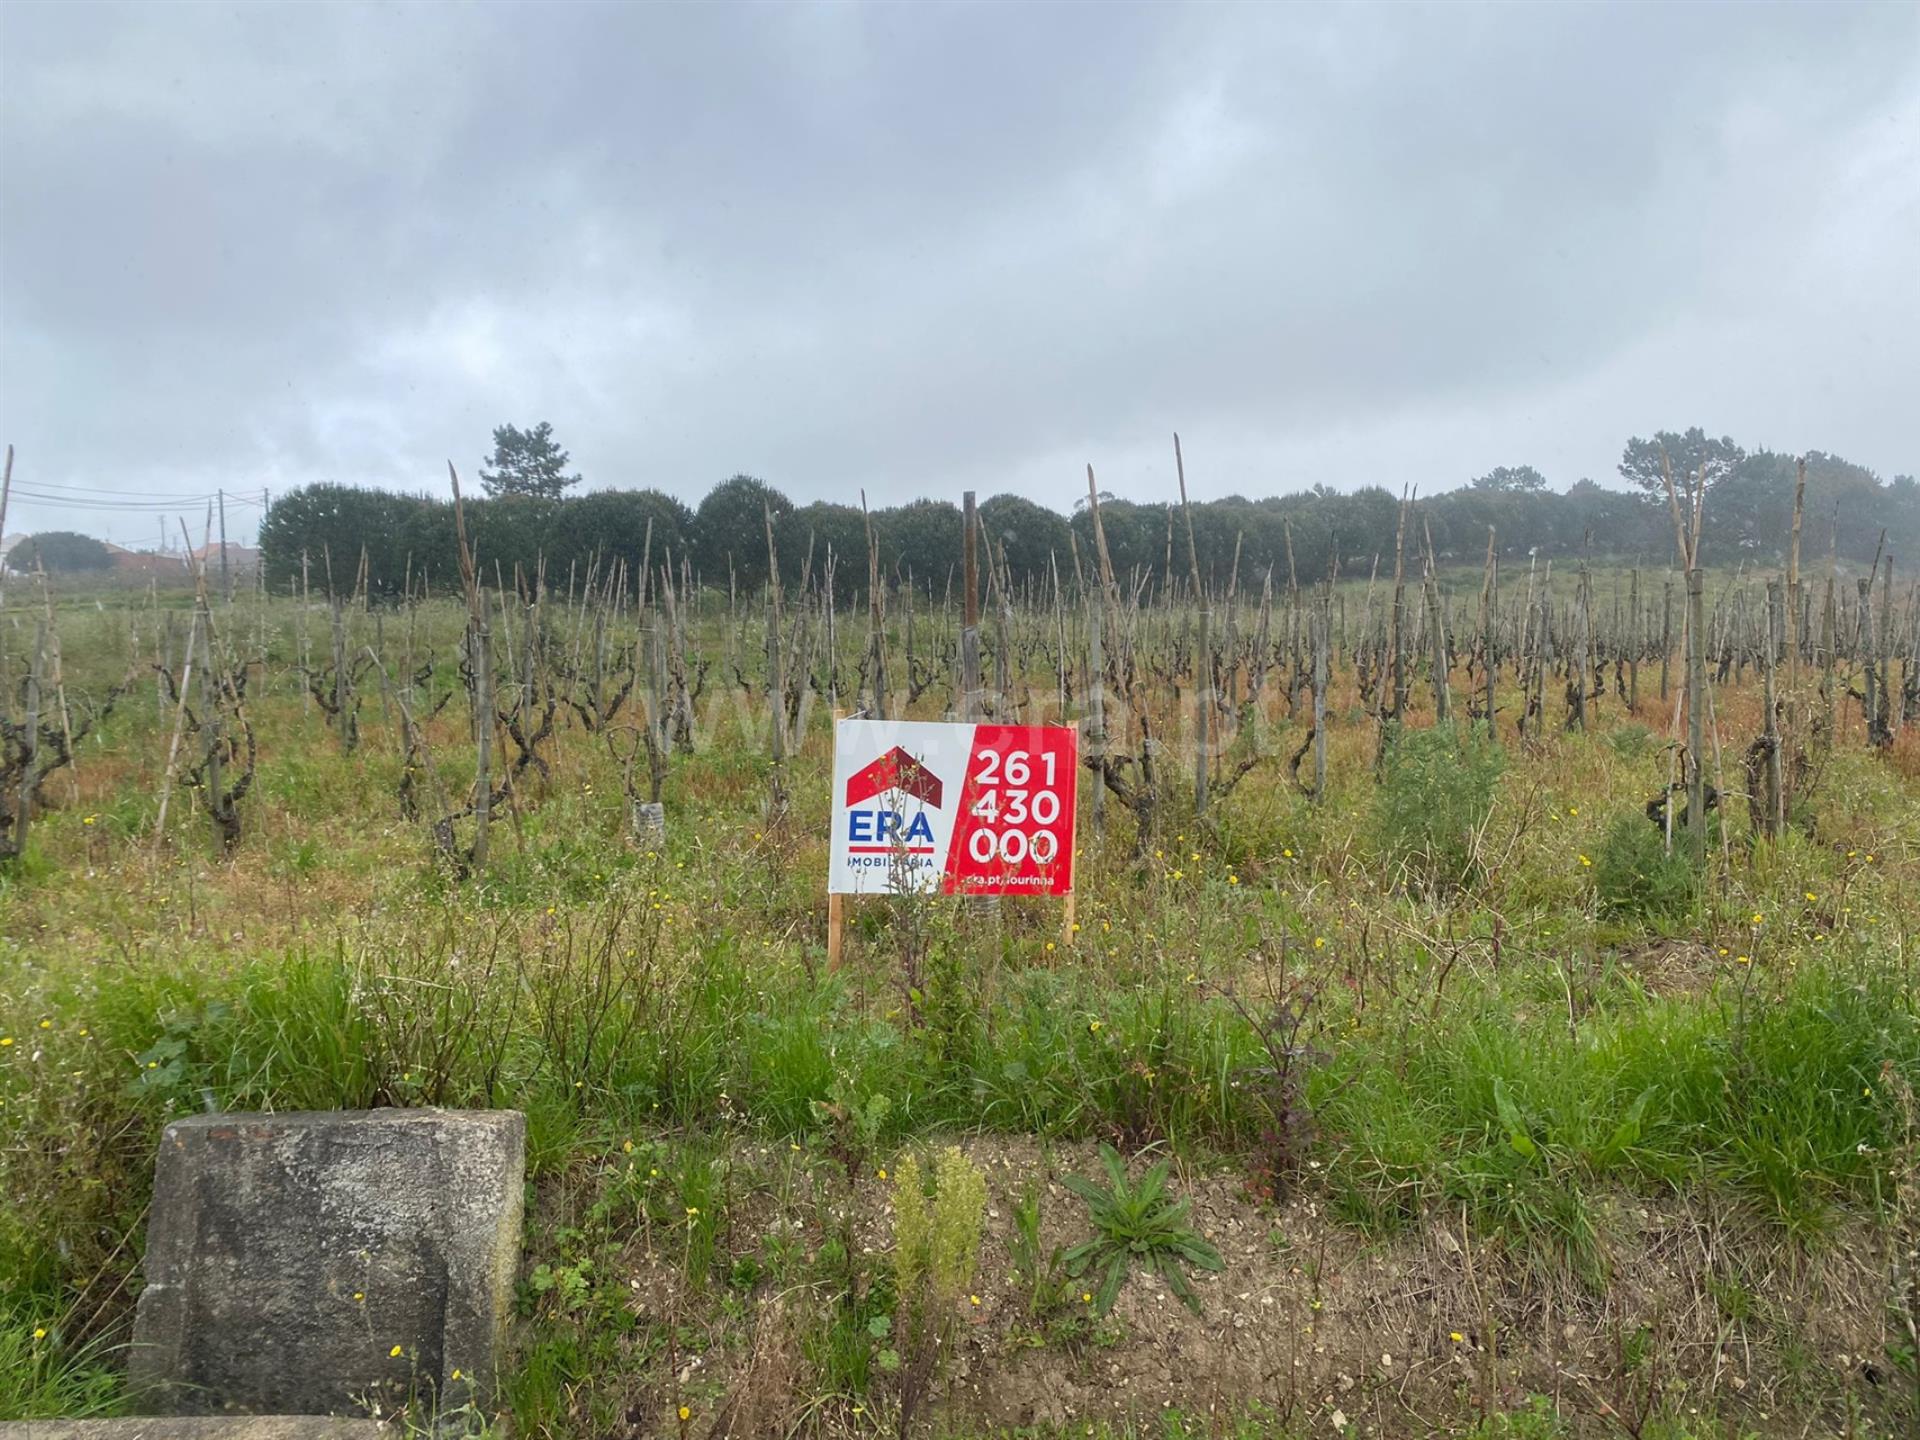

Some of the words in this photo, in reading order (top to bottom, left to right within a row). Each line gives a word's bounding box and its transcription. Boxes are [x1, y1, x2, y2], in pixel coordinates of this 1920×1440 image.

[976, 749, 1056, 786] 261
[971, 789, 1060, 825] 430
[848, 810, 935, 843] ERA
[847, 855, 934, 868] IMOBILRIA
[968, 828, 1058, 864] 000
